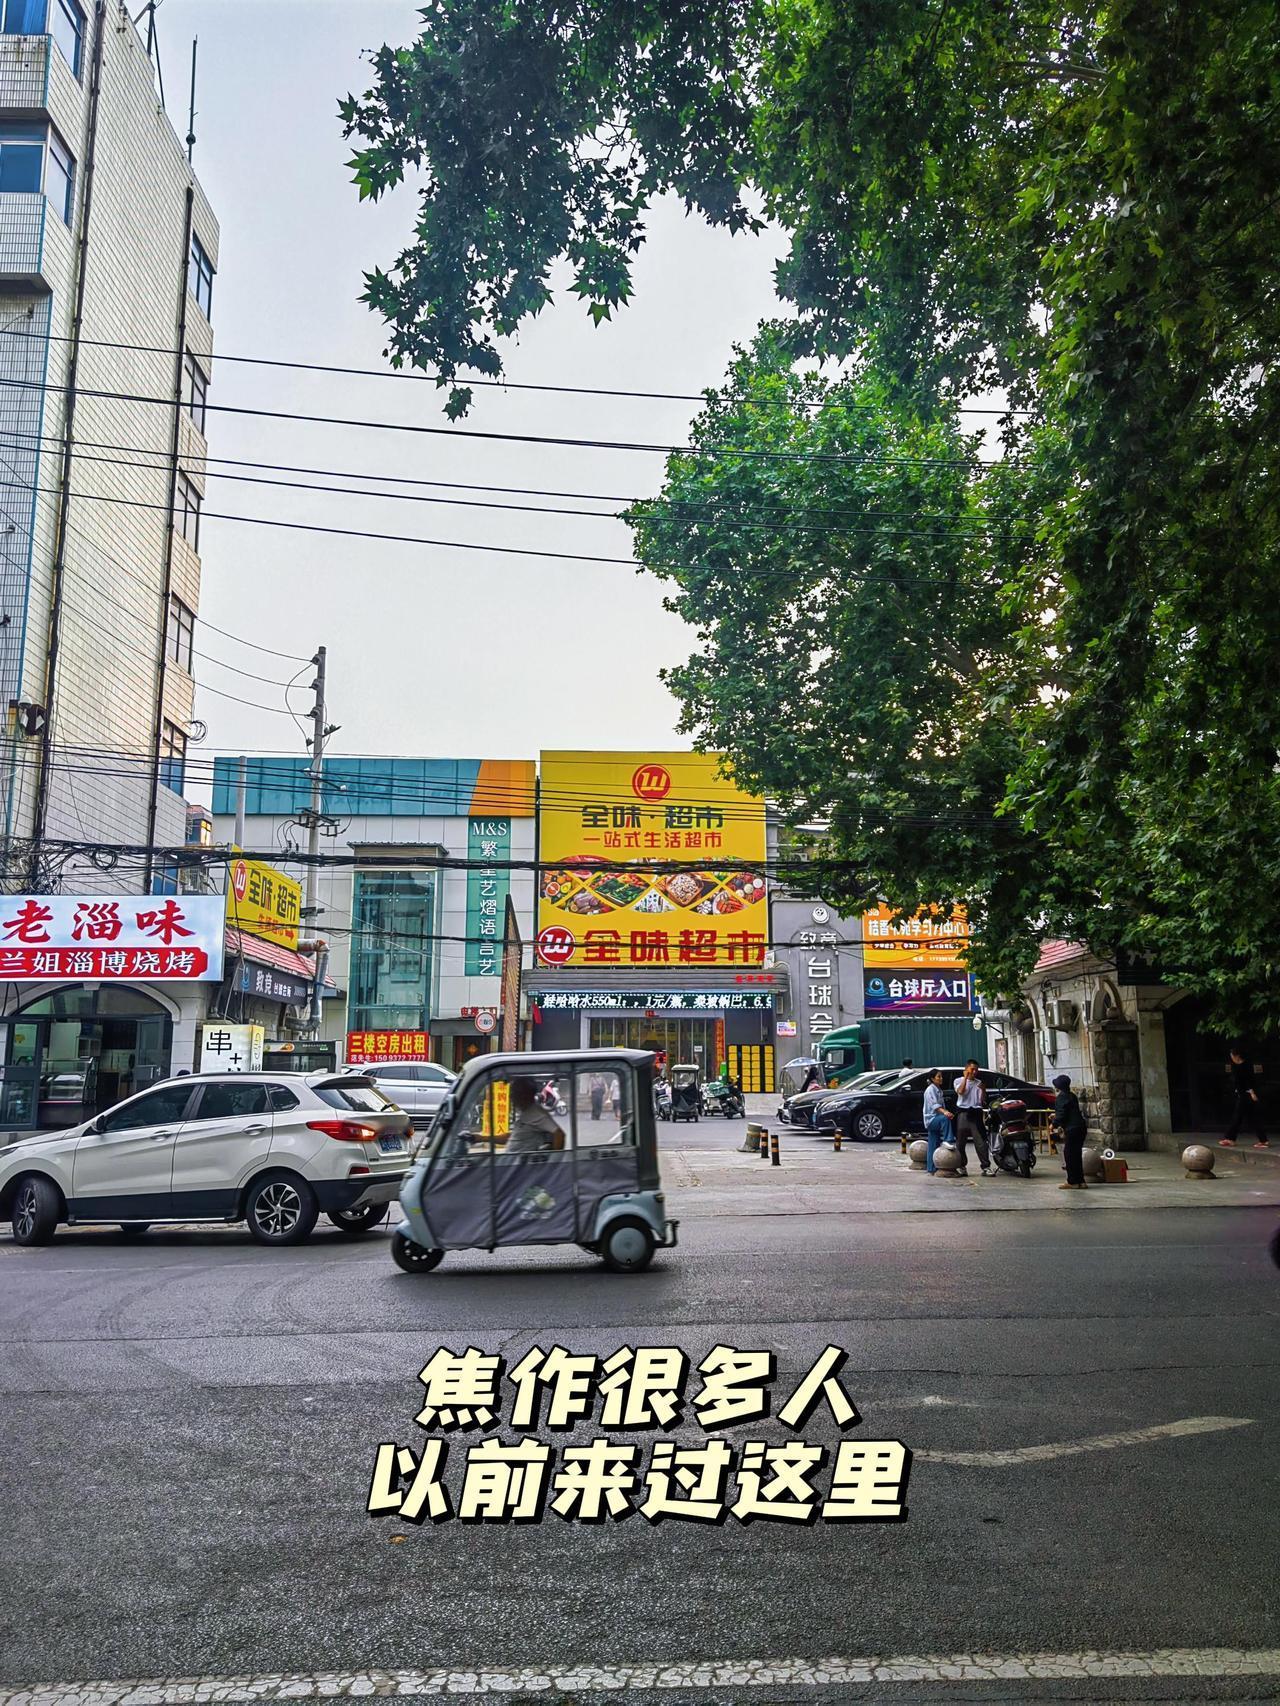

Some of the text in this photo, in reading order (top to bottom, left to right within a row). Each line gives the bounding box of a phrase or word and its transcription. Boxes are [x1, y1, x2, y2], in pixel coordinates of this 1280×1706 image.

[472, 822, 507, 836] M&S
[583, 831, 722, 848] 一站式生活超市
[1, 900, 196, 945] 老淄味
[582, 929, 766, 963] 全味超市
[0, 951, 196, 975] 兰姐淄博烧烤
[888, 979, 967, 998] 台球厅入口
[351, 1033, 426, 1054] 三楼空房出租
